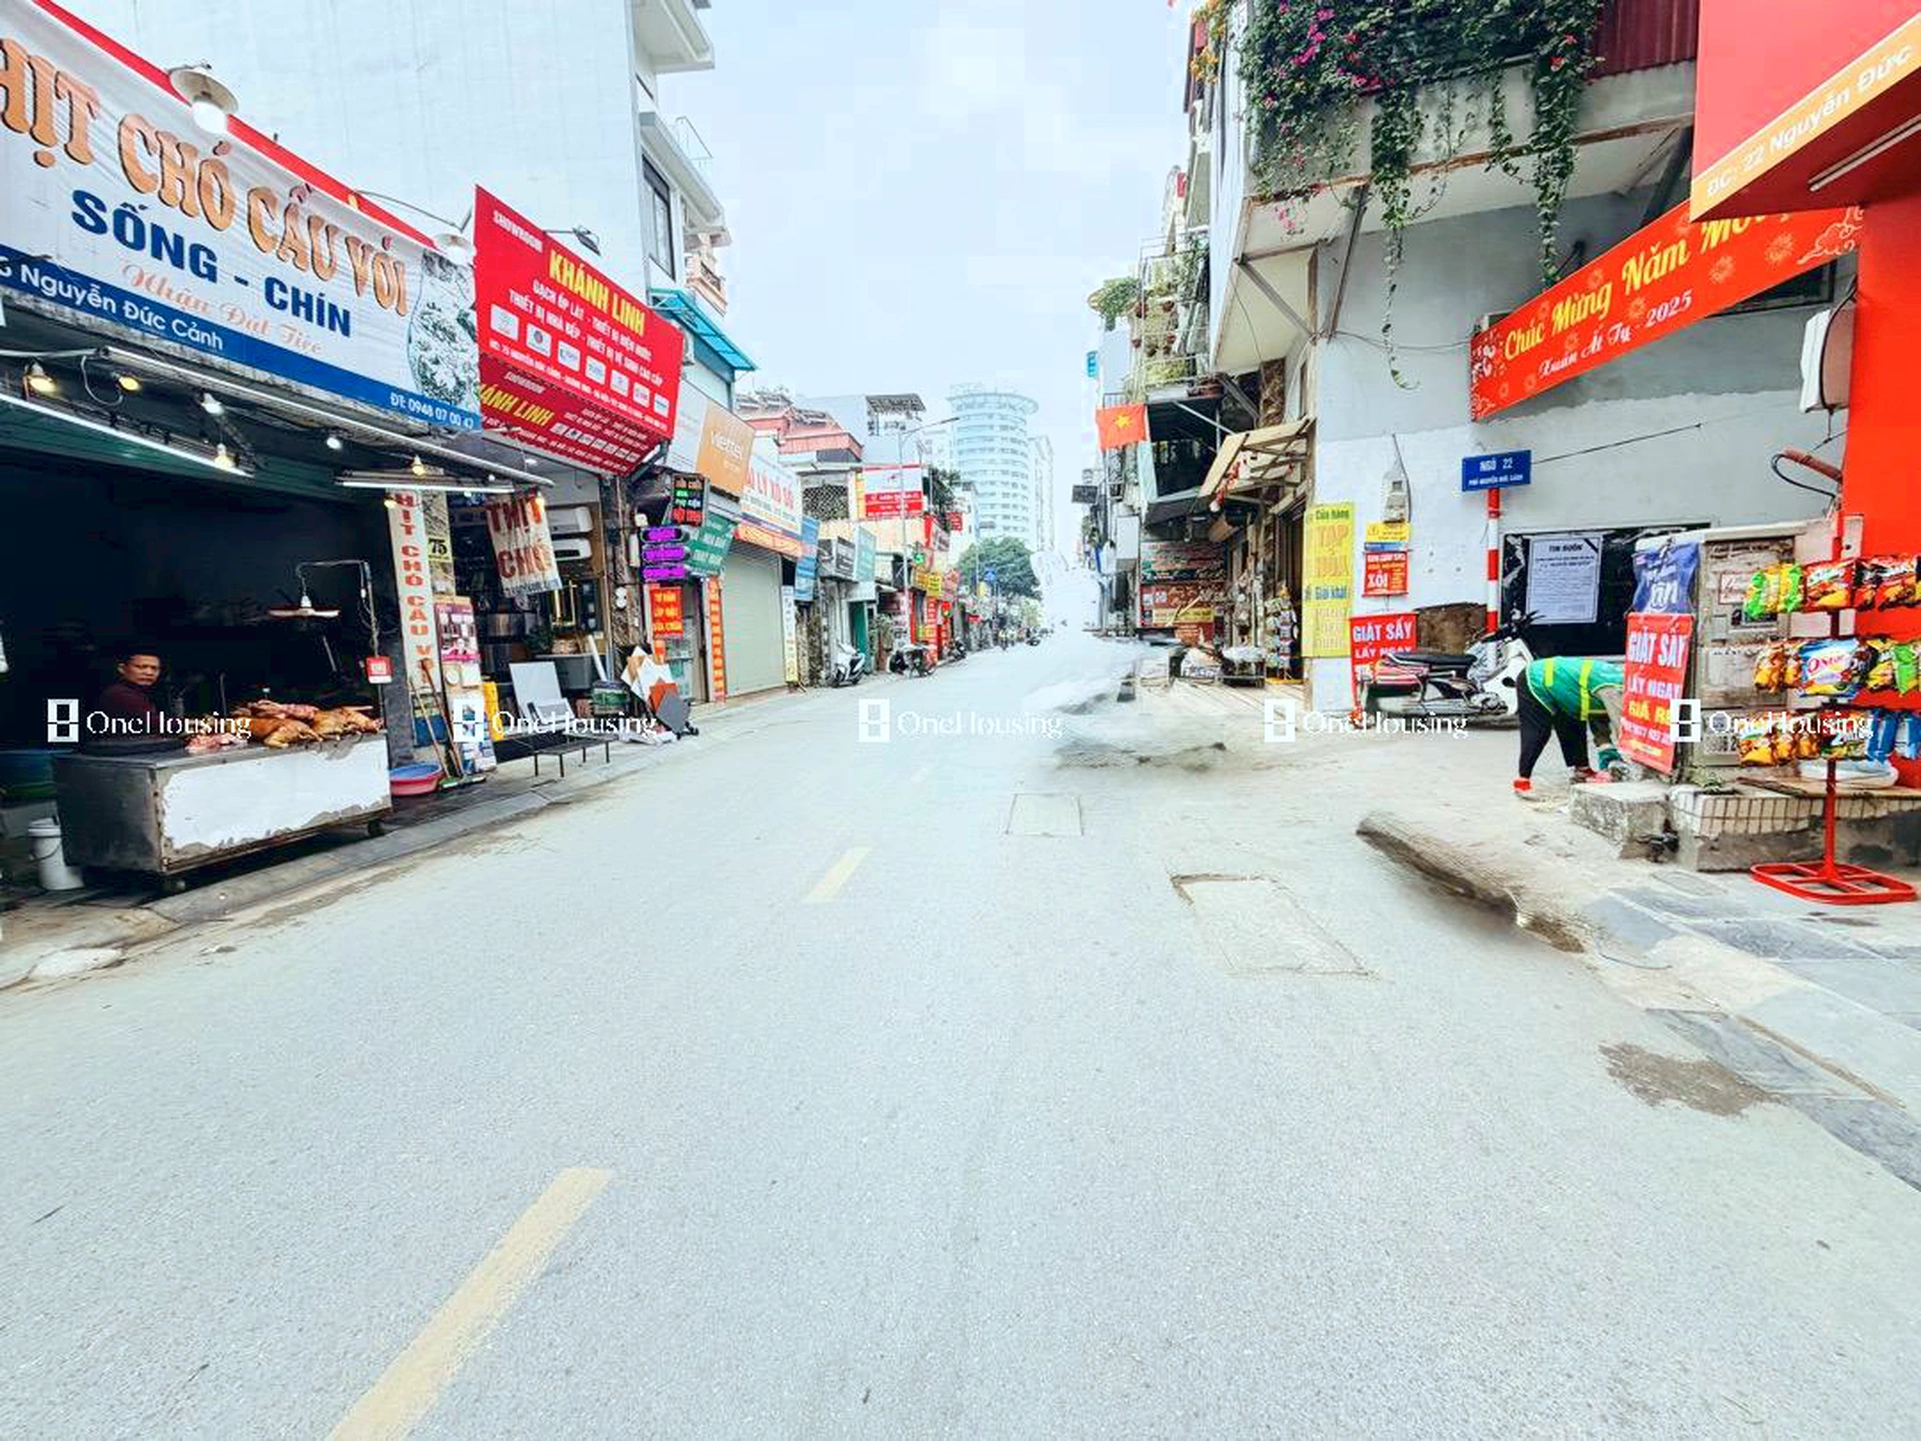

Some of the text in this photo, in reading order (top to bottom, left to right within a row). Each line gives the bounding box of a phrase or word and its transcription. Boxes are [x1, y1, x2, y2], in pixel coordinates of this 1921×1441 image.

[118, 113, 237, 231] CHÓ
[1742, 145, 1764, 172] 22
[72, 189, 217, 284] SỐNG
[264, 276, 351, 338] CHÍN
[549, 250, 645, 337] KHÁNH LINH
[20, 263, 117, 314] Nguyễn
[123, 300, 167, 330] Đức
[171, 318, 223, 350] Cảnh
[1503, 317, 1544, 360] Chúc
[1551, 281, 1613, 336] Mừng
[1621, 239, 1691, 296] Năm
[1644, 290, 1693, 329] 2025
[480, 384, 519, 413] ÁNH
[513, 400, 555, 427] LINH
[1502, 457, 1513, 469] 22
[430, 537, 448, 554] 75
